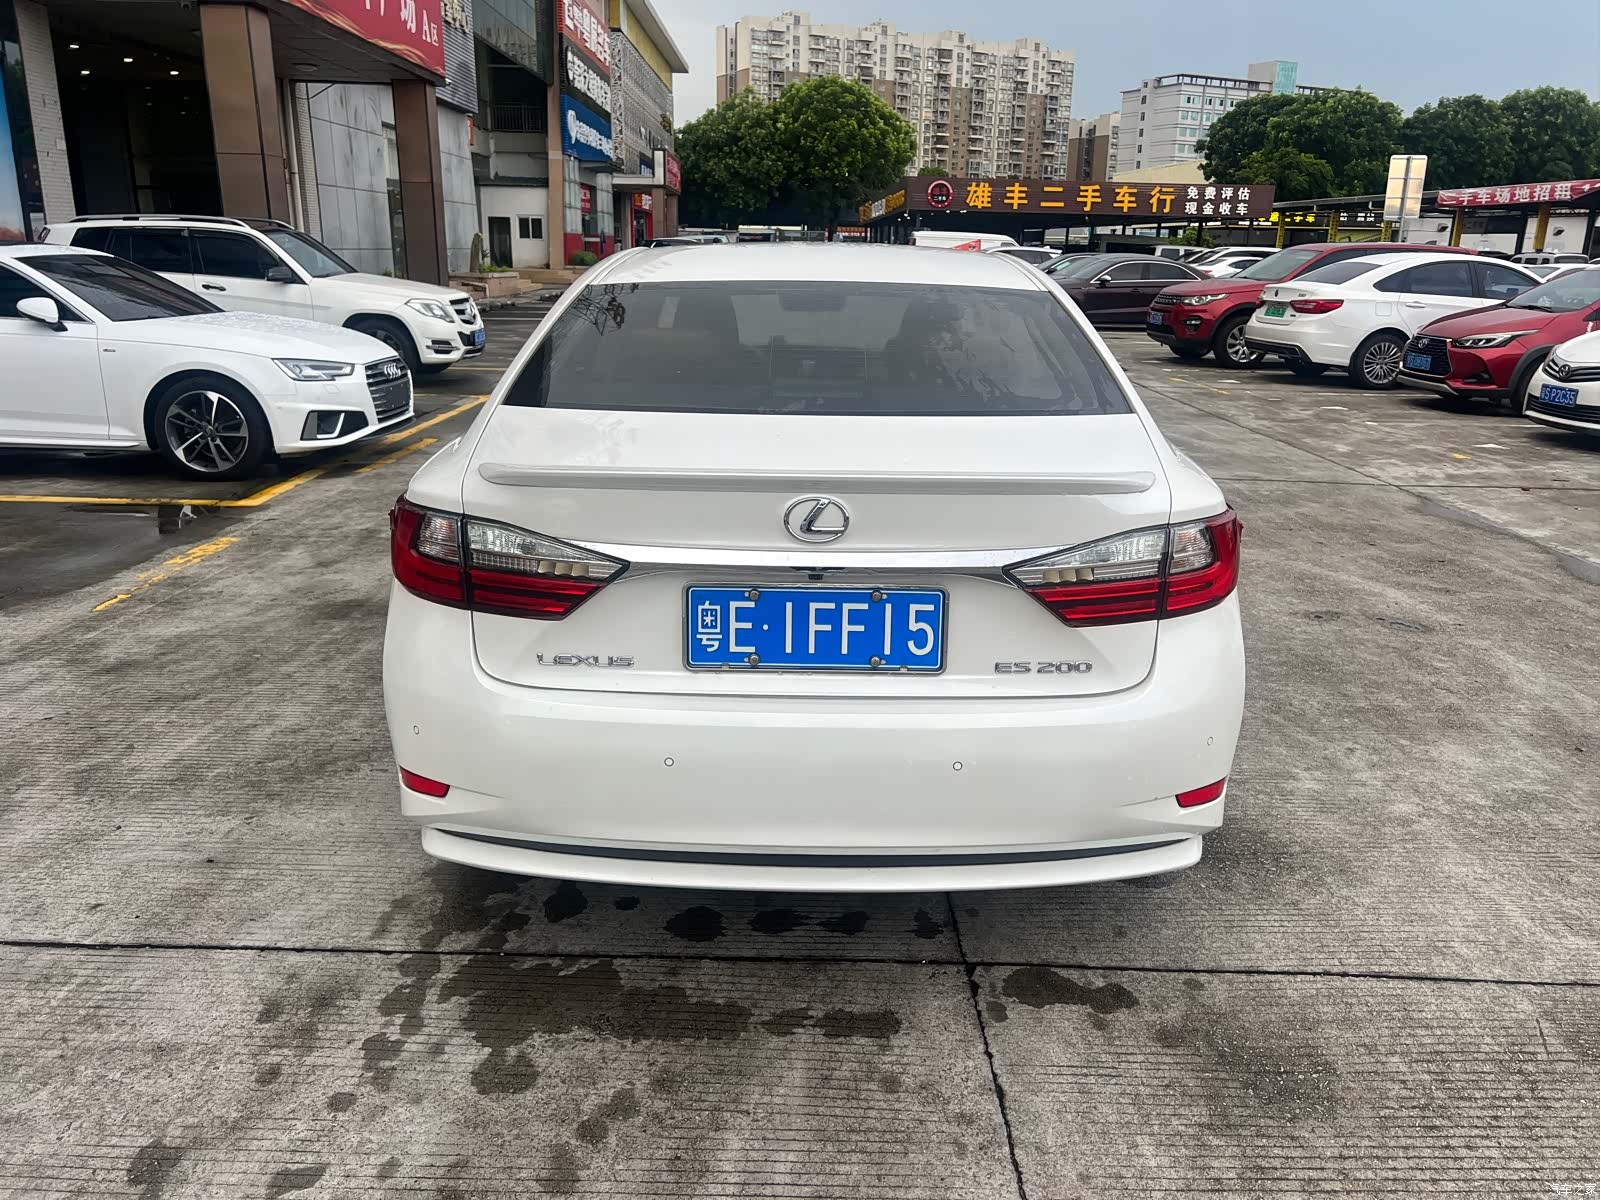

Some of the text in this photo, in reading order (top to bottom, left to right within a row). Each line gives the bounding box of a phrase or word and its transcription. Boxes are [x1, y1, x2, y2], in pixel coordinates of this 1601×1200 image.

[966, 181, 1176, 213] 雄丰二手车行
[1186, 186, 1250, 201] 免费评估
[1436, 183, 1573, 206] 二手车场地招租
[1185, 202, 1249, 216] 现金收车
[536, 652, 634, 668] LEXUS
[995, 661, 1093, 674] ES 200
